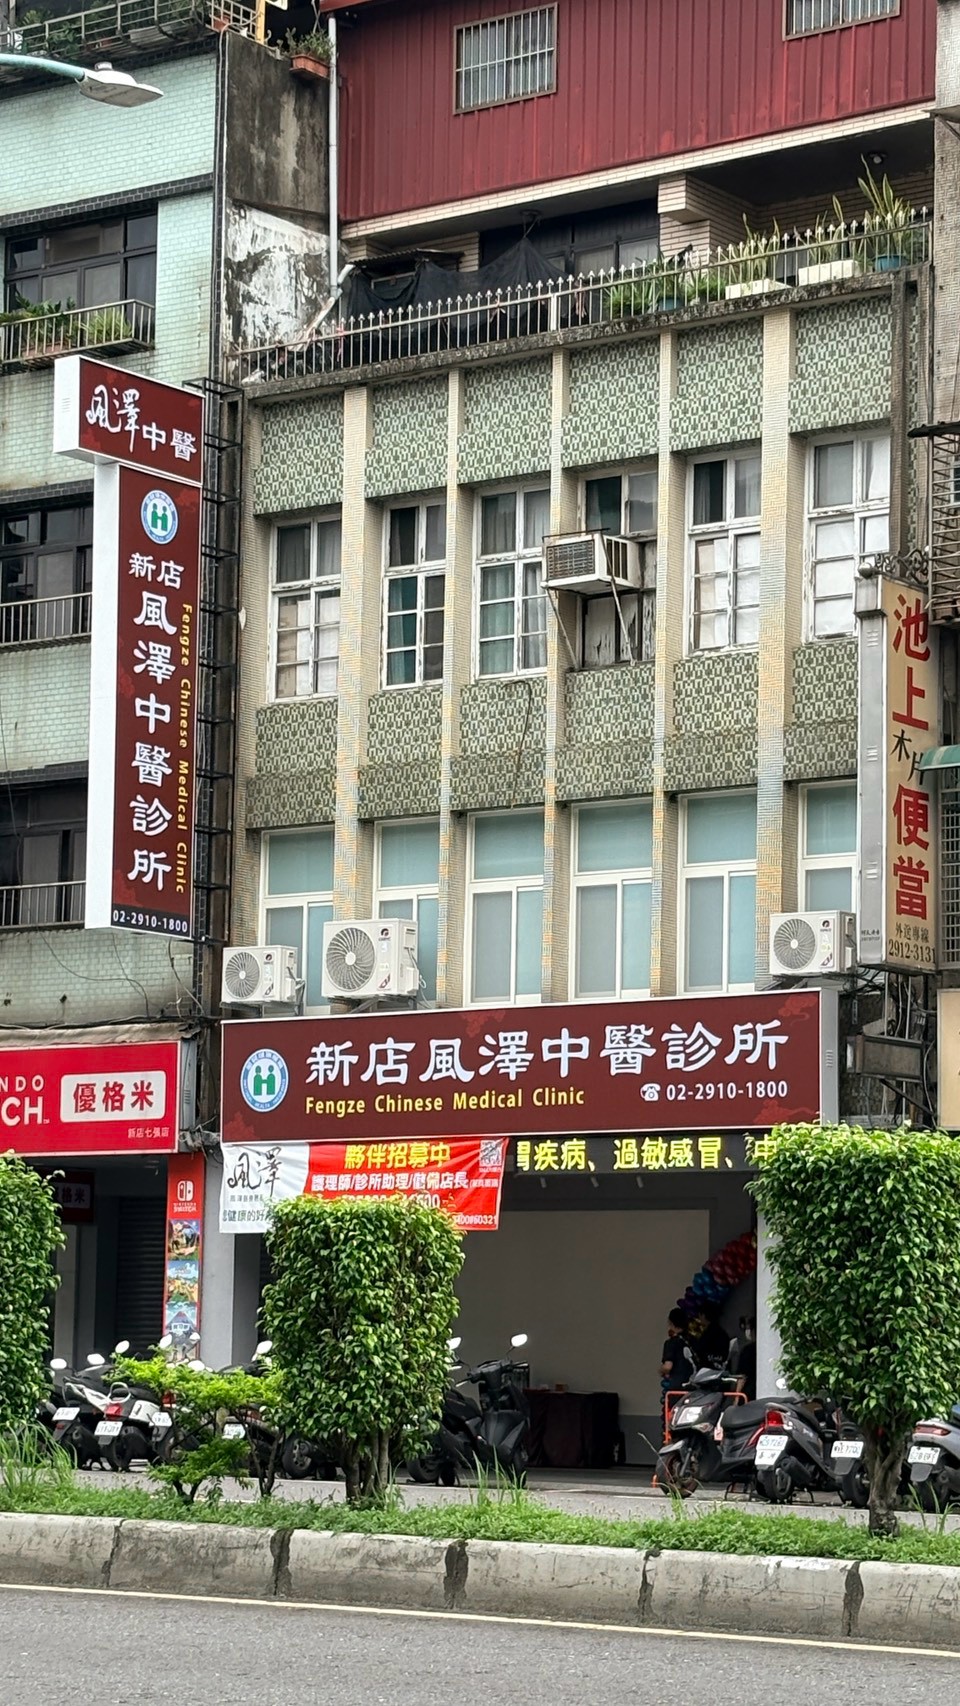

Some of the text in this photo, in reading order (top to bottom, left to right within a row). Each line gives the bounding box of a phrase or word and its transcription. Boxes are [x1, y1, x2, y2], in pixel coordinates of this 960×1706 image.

[128, 552, 184, 590] 新店
[127, 591, 178, 891] 風澤中醫診所
[175, 603, 193, 893] Fengze Chinese Medical Clinic
[113, 909, 188, 933] 02-2910-1800
[888, 938, 936, 964] 2912-3131
[305, 1019, 789, 1087] 新店風澤中醫診所
[73, 1080, 154, 1114] 優格米
[305, 1086, 585, 1118] Fengze Chinese Medical Clinic
[666, 1080, 788, 1101] 02-2910-1800
[344, 1141, 451, 1169] 夥伴招募中
